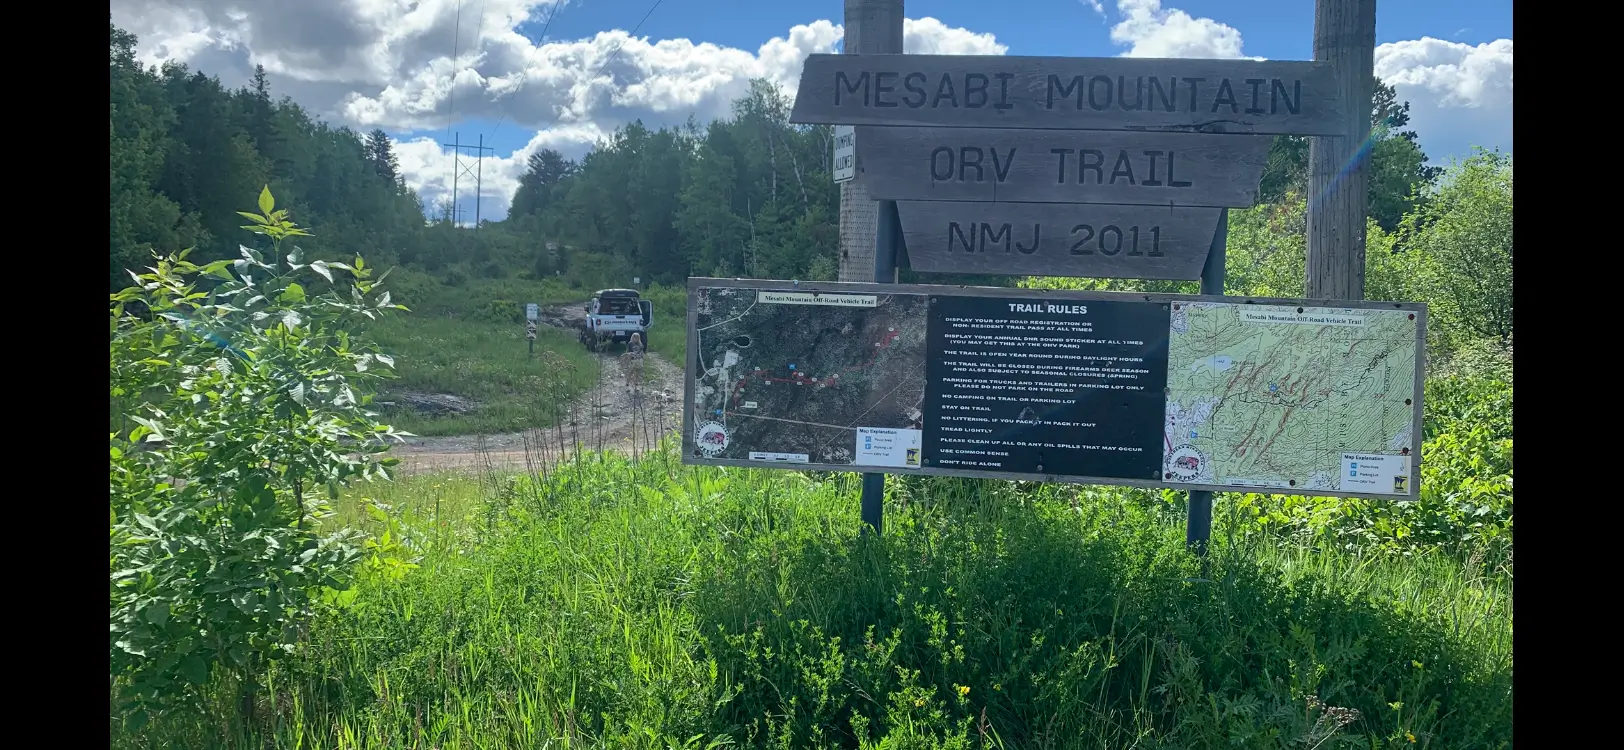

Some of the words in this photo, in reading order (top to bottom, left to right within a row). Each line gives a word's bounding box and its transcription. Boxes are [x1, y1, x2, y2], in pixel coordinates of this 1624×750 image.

[834, 71, 1014, 109] MESABI
[1046, 74, 1301, 115] MOUNTAIN
[930, 146, 1016, 182] ORV
[1050, 149, 1192, 187] TRAIL
[948, 221, 1041, 255] NMJ
[1070, 224, 1164, 257] 2011
[1009, 303, 1044, 313] TRAIL
[1047, 304, 1087, 315] RULES
